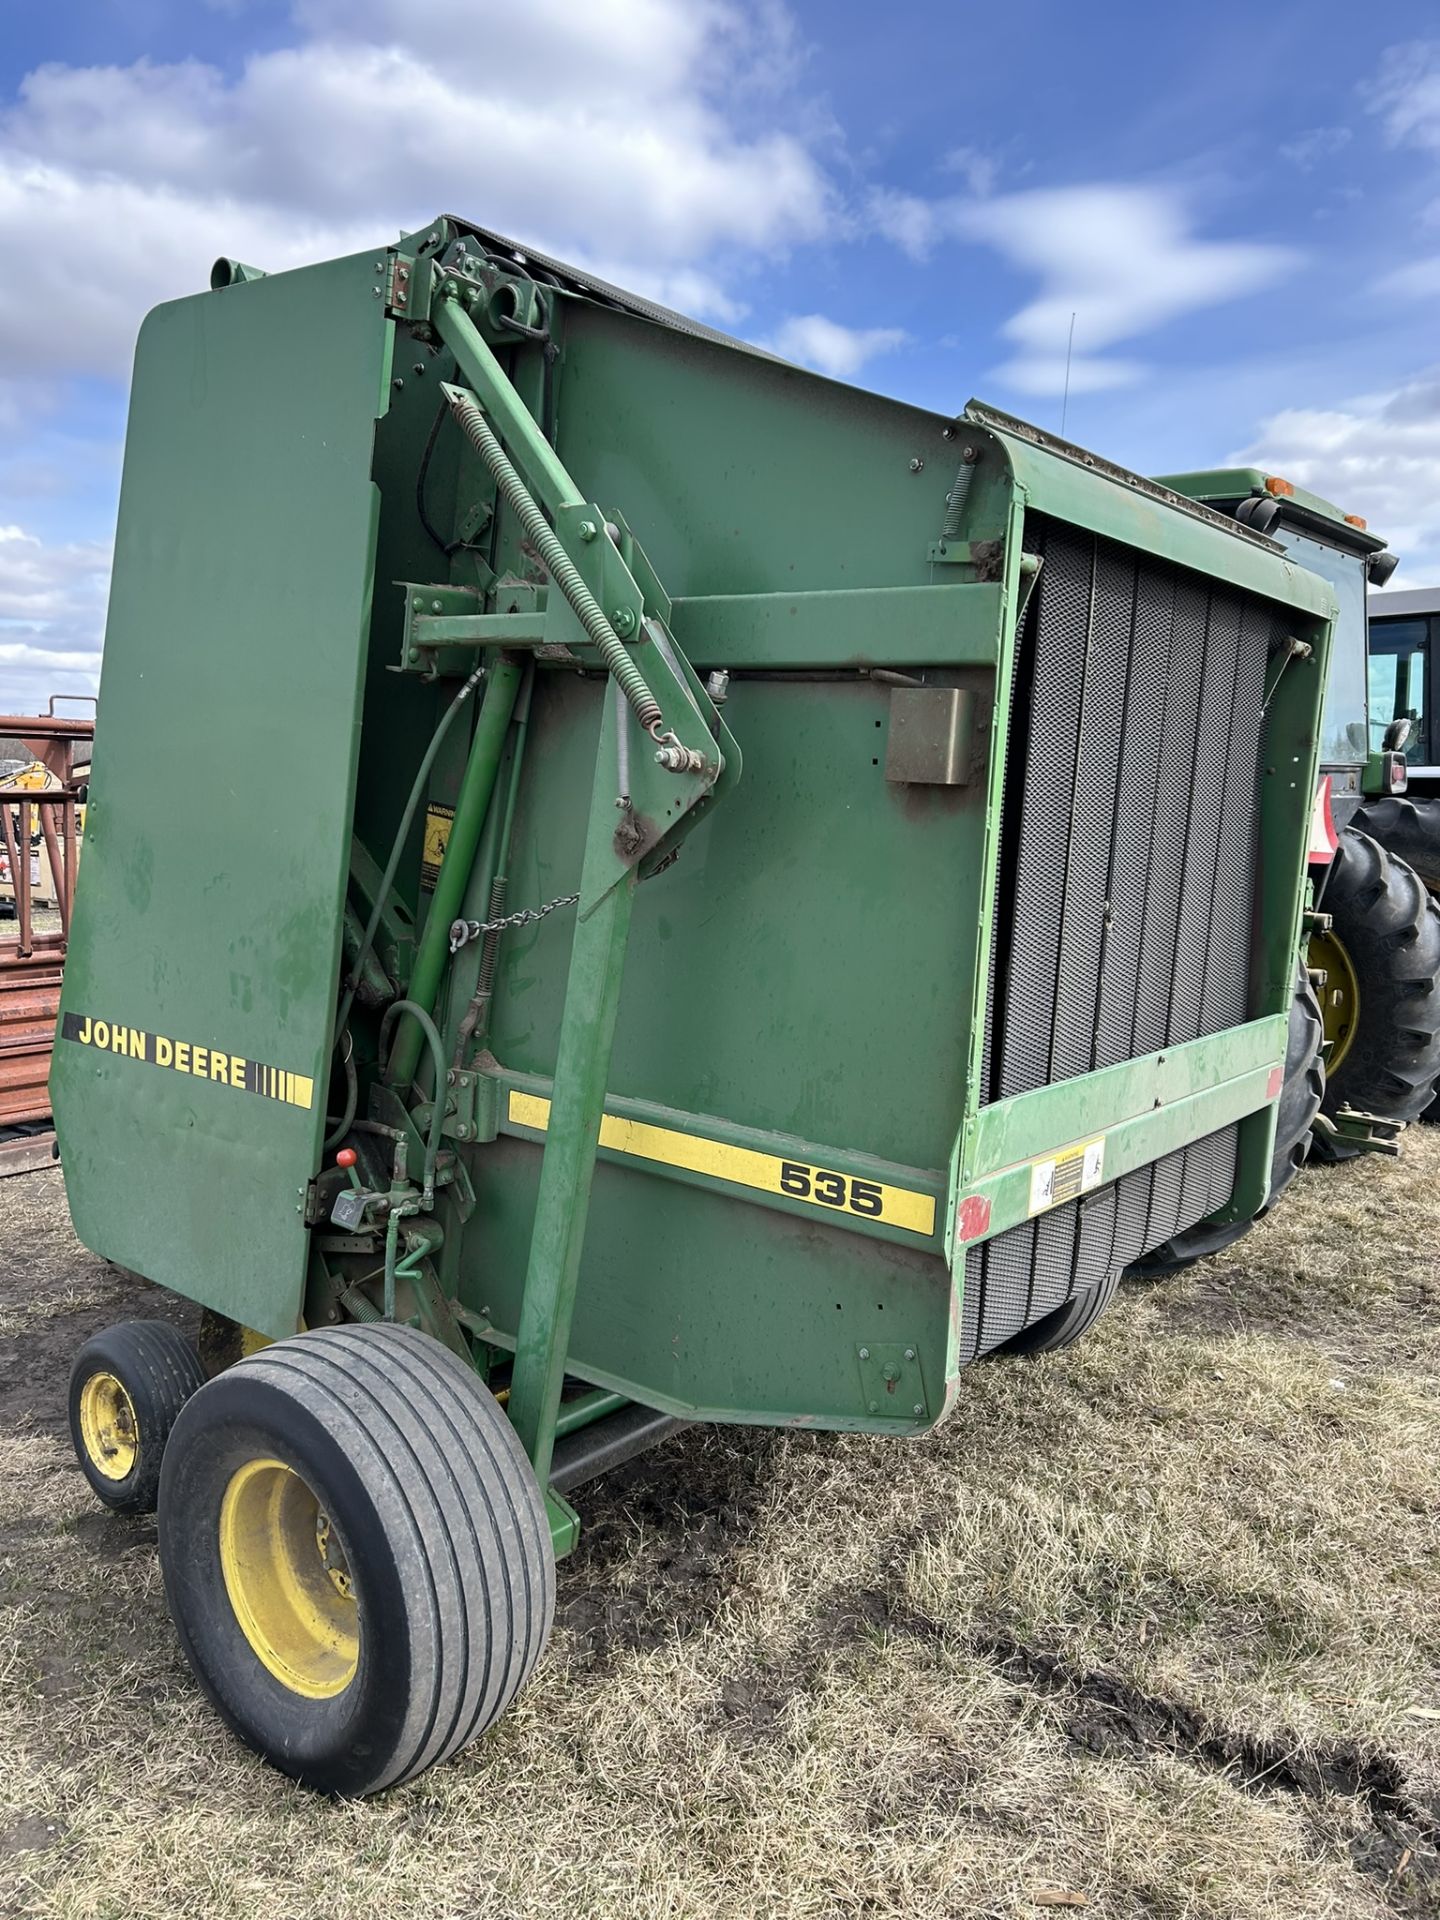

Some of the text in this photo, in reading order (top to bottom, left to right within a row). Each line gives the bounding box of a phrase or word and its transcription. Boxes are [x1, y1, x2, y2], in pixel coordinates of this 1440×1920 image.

[79, 1017, 247, 1089] JOHN DEERE
[780, 1162, 883, 1217] 535
